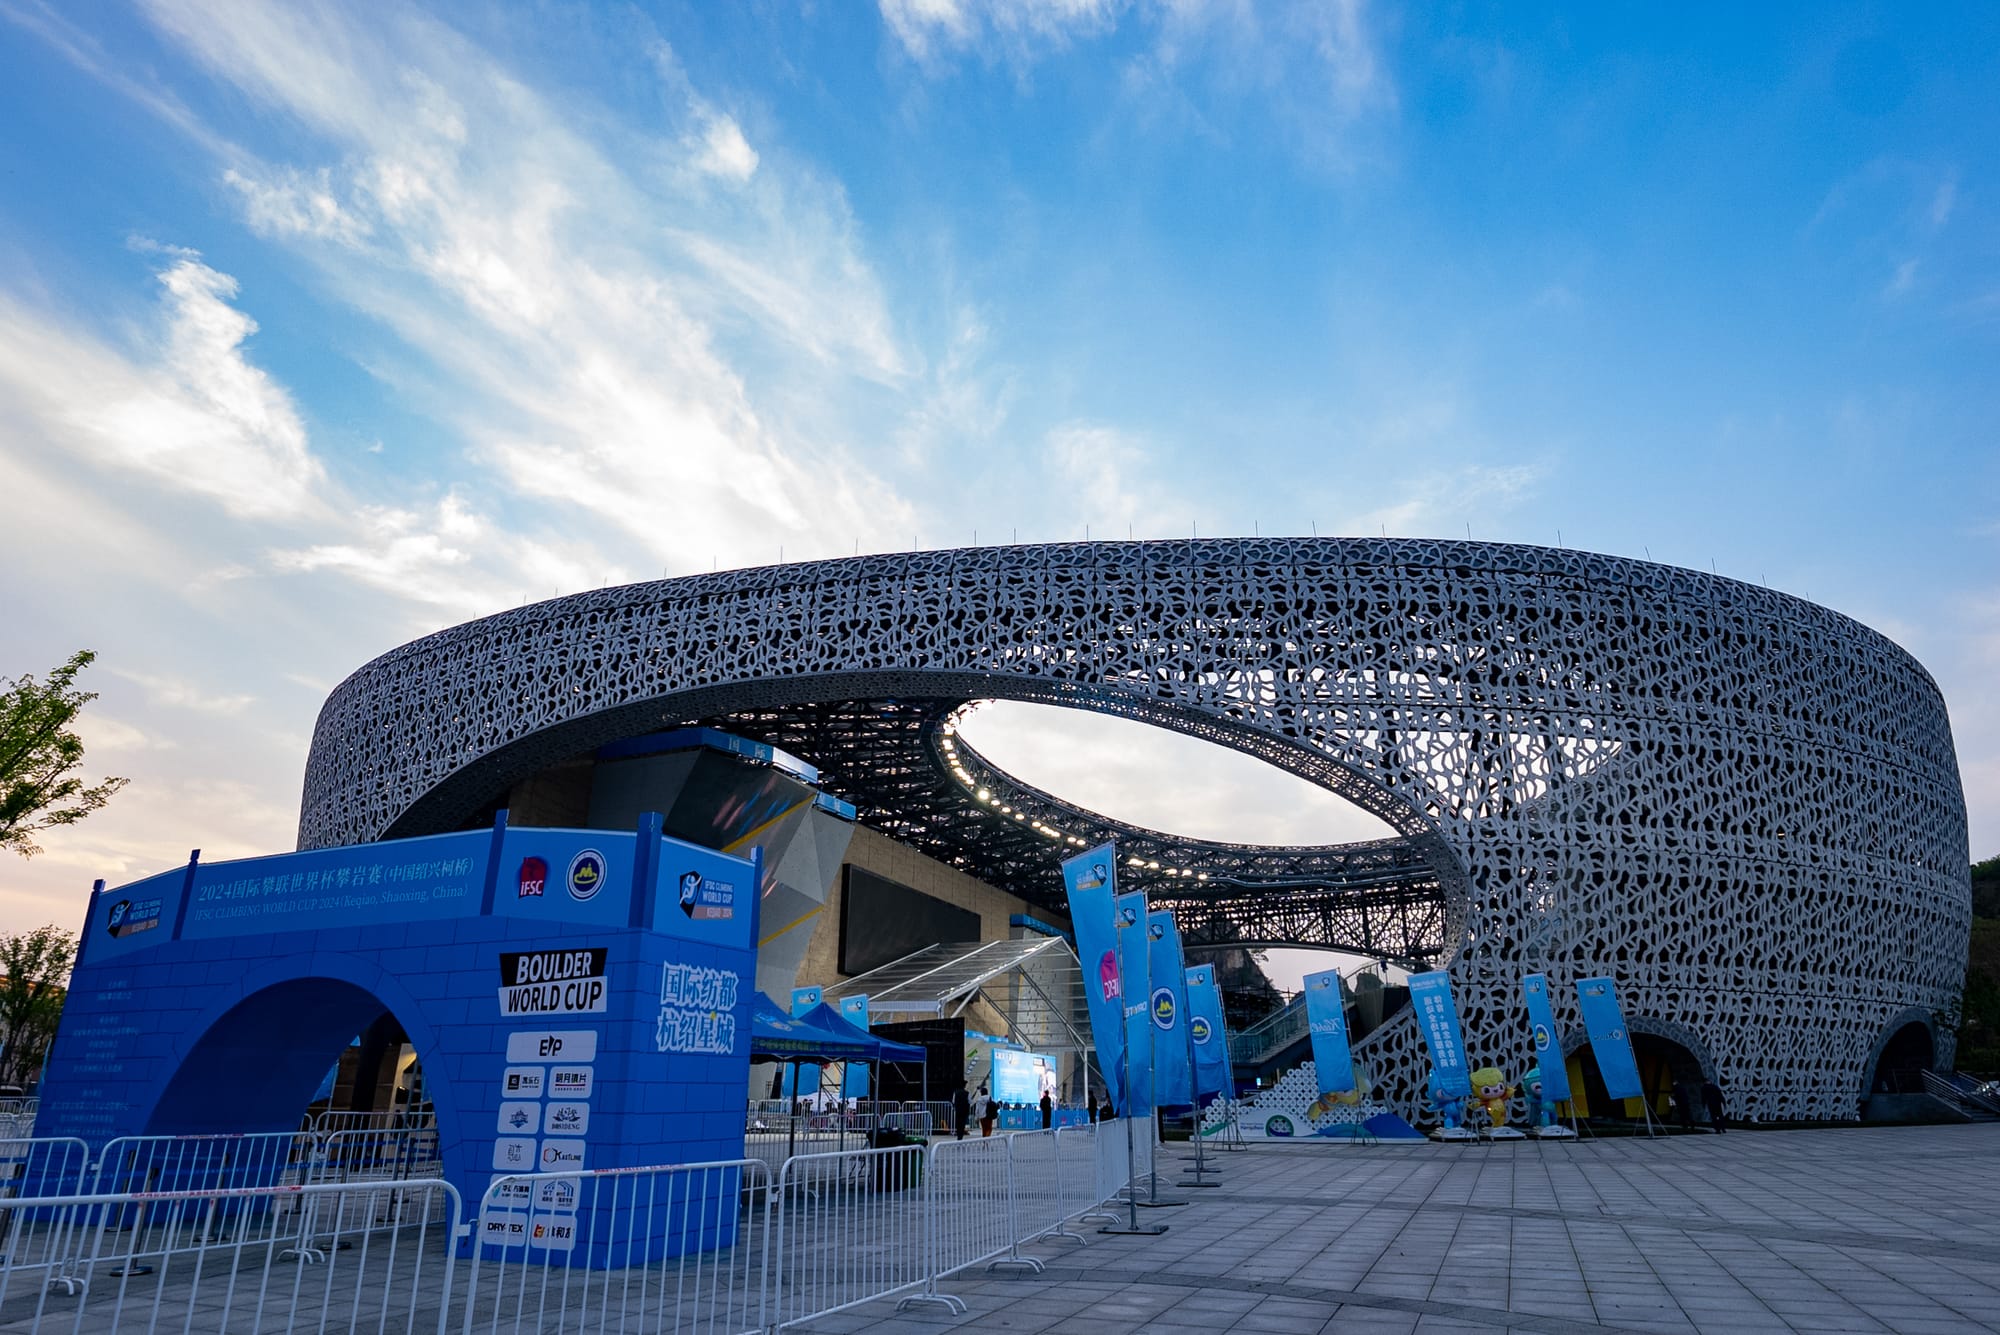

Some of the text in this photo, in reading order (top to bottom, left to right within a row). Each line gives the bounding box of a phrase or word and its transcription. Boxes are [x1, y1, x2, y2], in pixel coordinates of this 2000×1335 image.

[215, 904, 260, 919] CLIMBING
[262, 901, 296, 914] WORLD
[297, 898, 318, 912] CUP
[516, 952, 592, 984] BOULDER
[508, 981, 602, 1013] WORLD CUP
[660, 960, 739, 1011] 国际纺都
[656, 1006, 735, 1054] 杭绍星城
